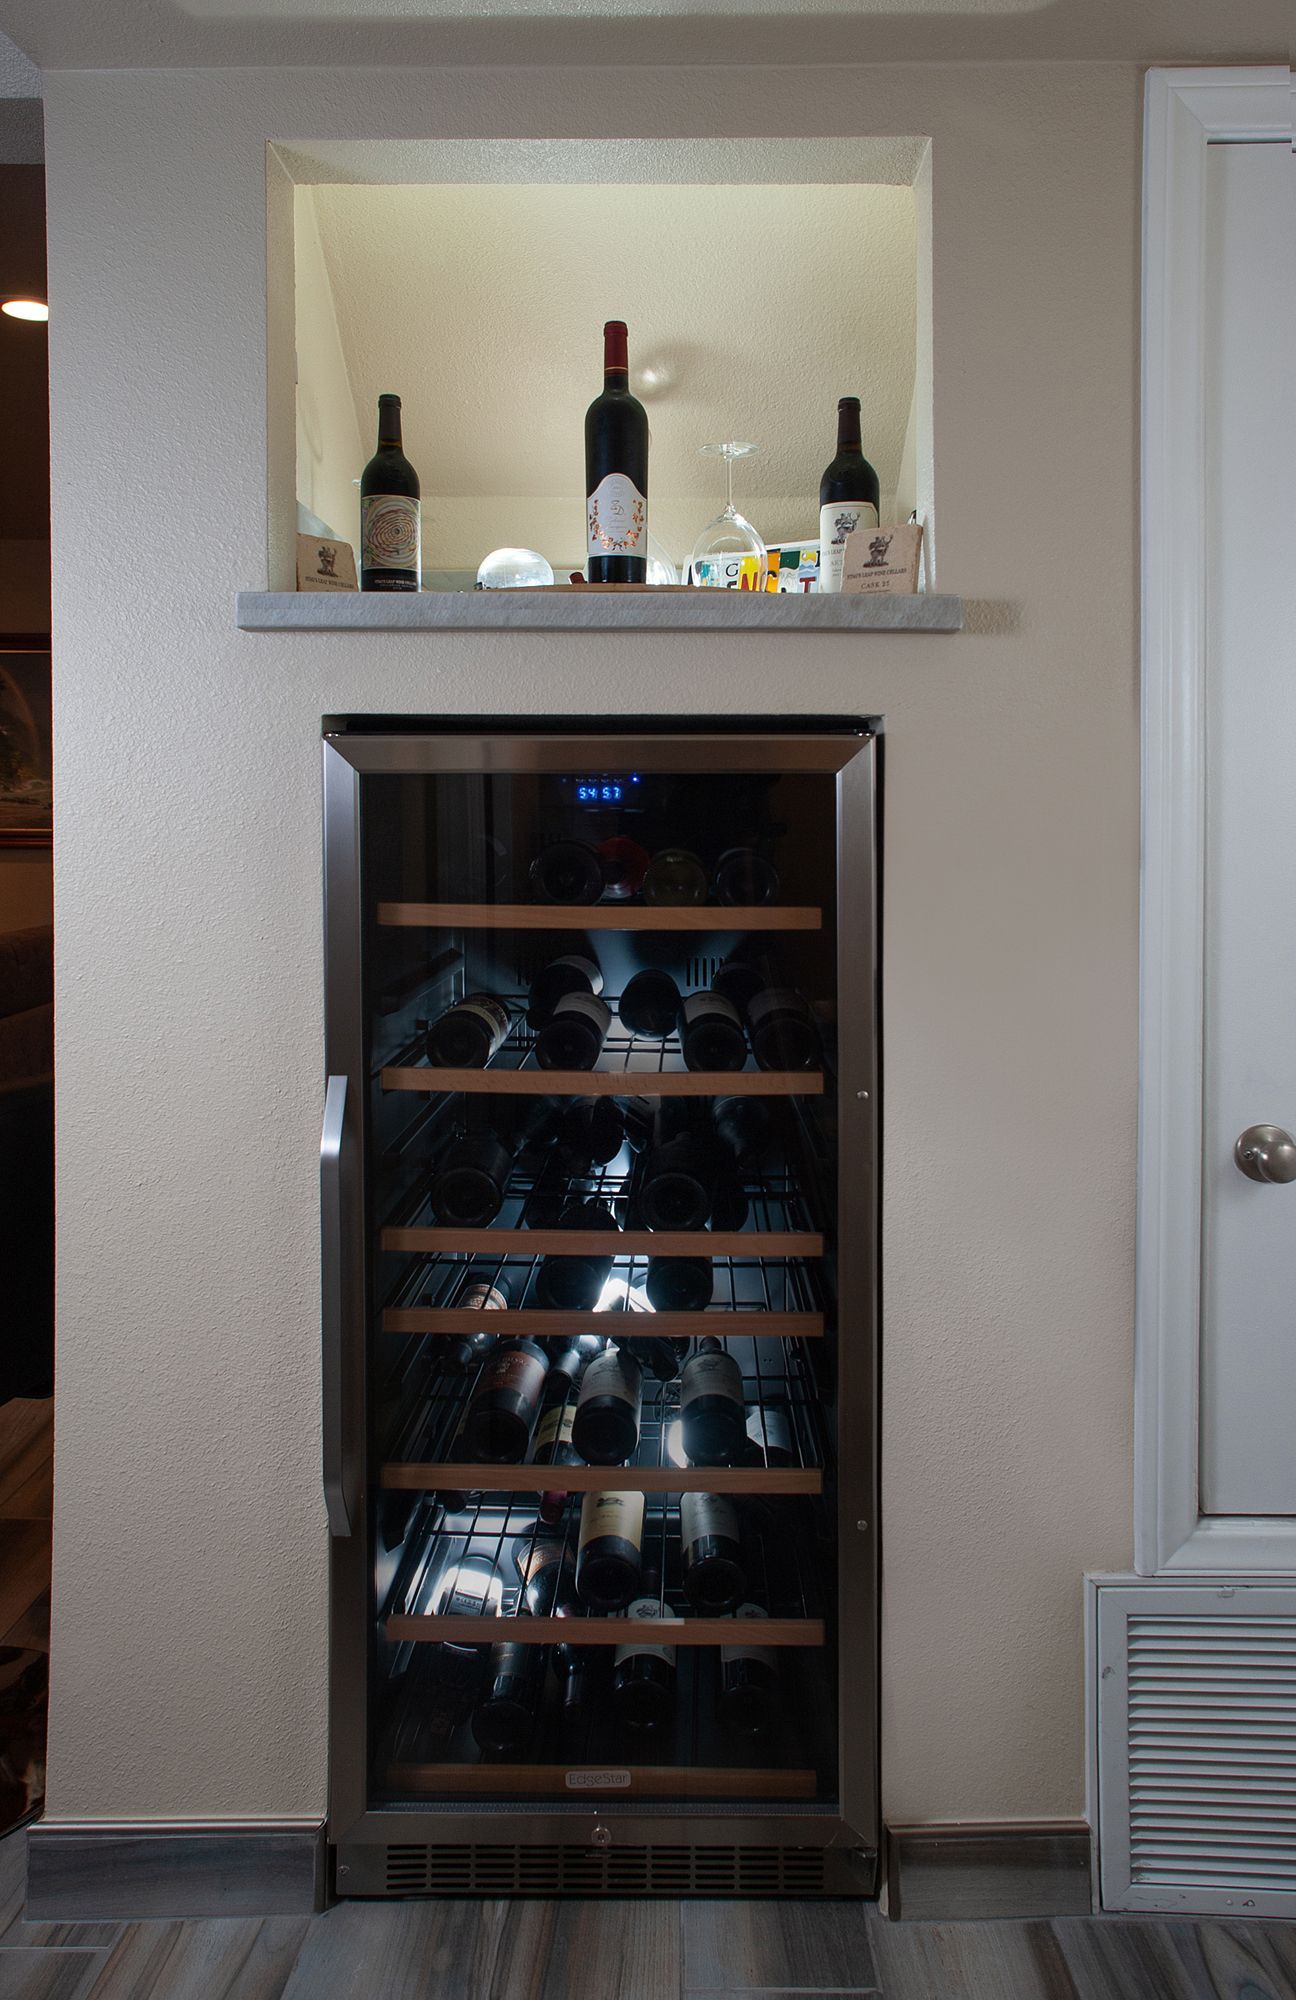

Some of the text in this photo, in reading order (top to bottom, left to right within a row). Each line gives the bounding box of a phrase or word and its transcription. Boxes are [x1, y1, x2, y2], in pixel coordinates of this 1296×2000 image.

[862, 571, 874, 579] LEAP
[874, 569, 887, 577] WINE
[886, 567, 907, 576] CELLARS
[861, 581, 881, 590] CASK
[568, 1772, 629, 1787] EdgeStar
